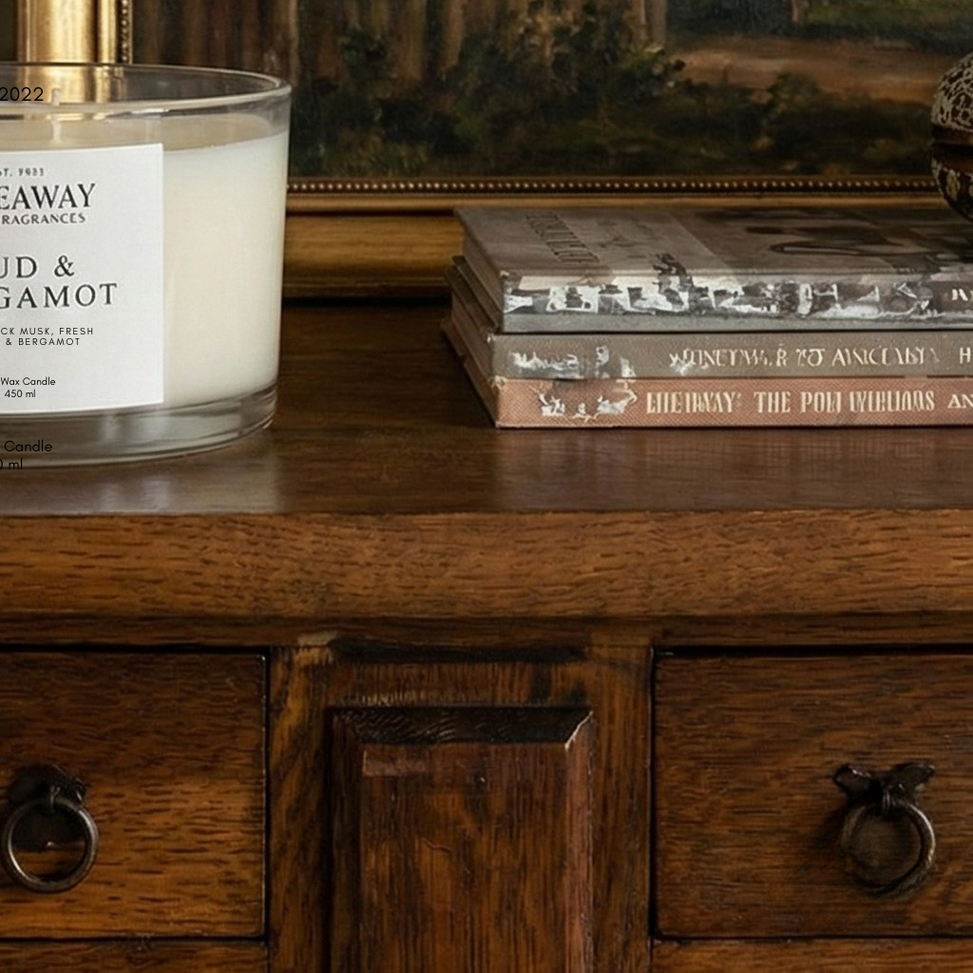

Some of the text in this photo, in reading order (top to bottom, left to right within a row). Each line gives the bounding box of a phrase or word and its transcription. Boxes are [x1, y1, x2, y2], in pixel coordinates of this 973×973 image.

[53, 254, 76, 278] &
[19, 327, 55, 337] MUSK,
[59, 327, 94, 336] FRESH
[5, 337, 14, 347] &
[18, 337, 81, 347] BERGAMOT
[0, 377, 20, 387] Wax
[22, 376, 57, 387] Candle
[4, 389, 37, 399] 450 ml
[754, 390, 791, 414] THE
